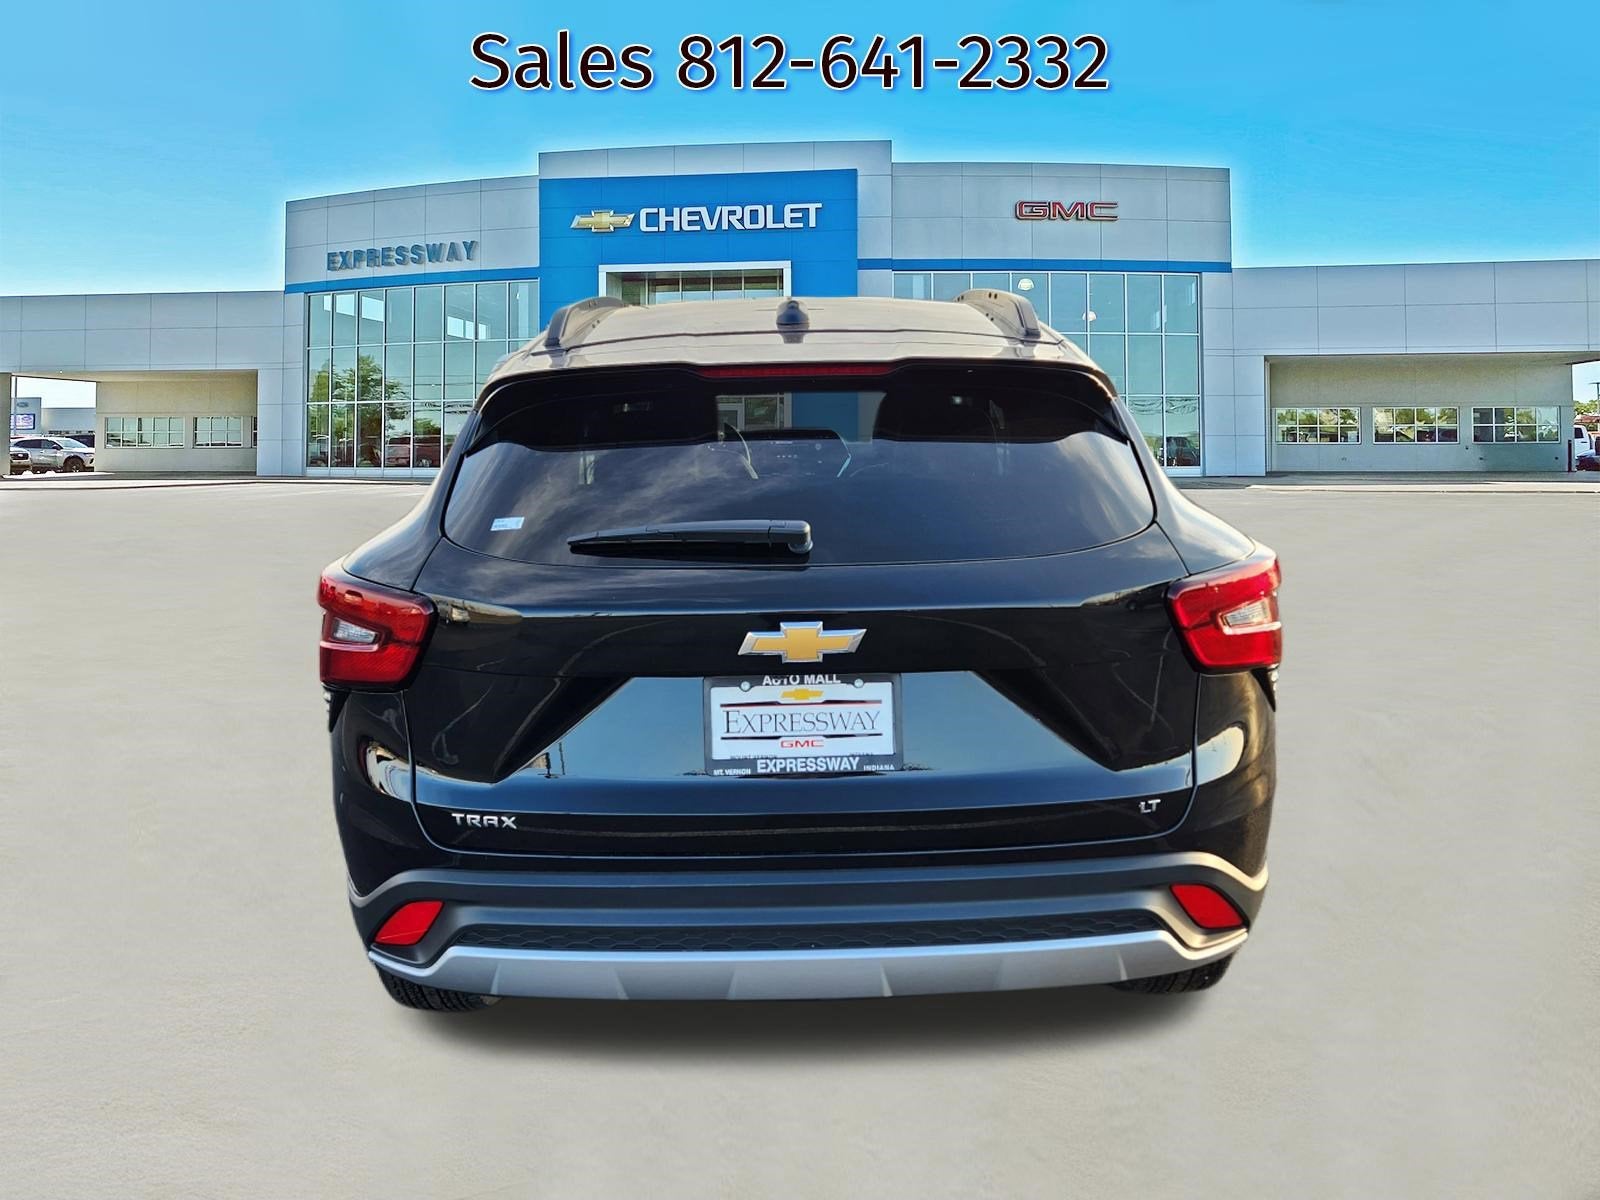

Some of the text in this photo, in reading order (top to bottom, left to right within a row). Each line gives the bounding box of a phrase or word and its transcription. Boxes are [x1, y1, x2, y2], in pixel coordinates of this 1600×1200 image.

[639, 202, 823, 233] CHEVROLET
[1014, 200, 1119, 221] GMC
[326, 240, 478, 271] EXPRESSWAY
[762, 674, 842, 686] AUTO MALL
[780, 739, 824, 748] GMC
[725, 768, 751, 776] VERNON
[756, 757, 860, 773] EXPRESSWAY
[1140, 799, 1161, 814] LT
[451, 813, 517, 829] TRAX
